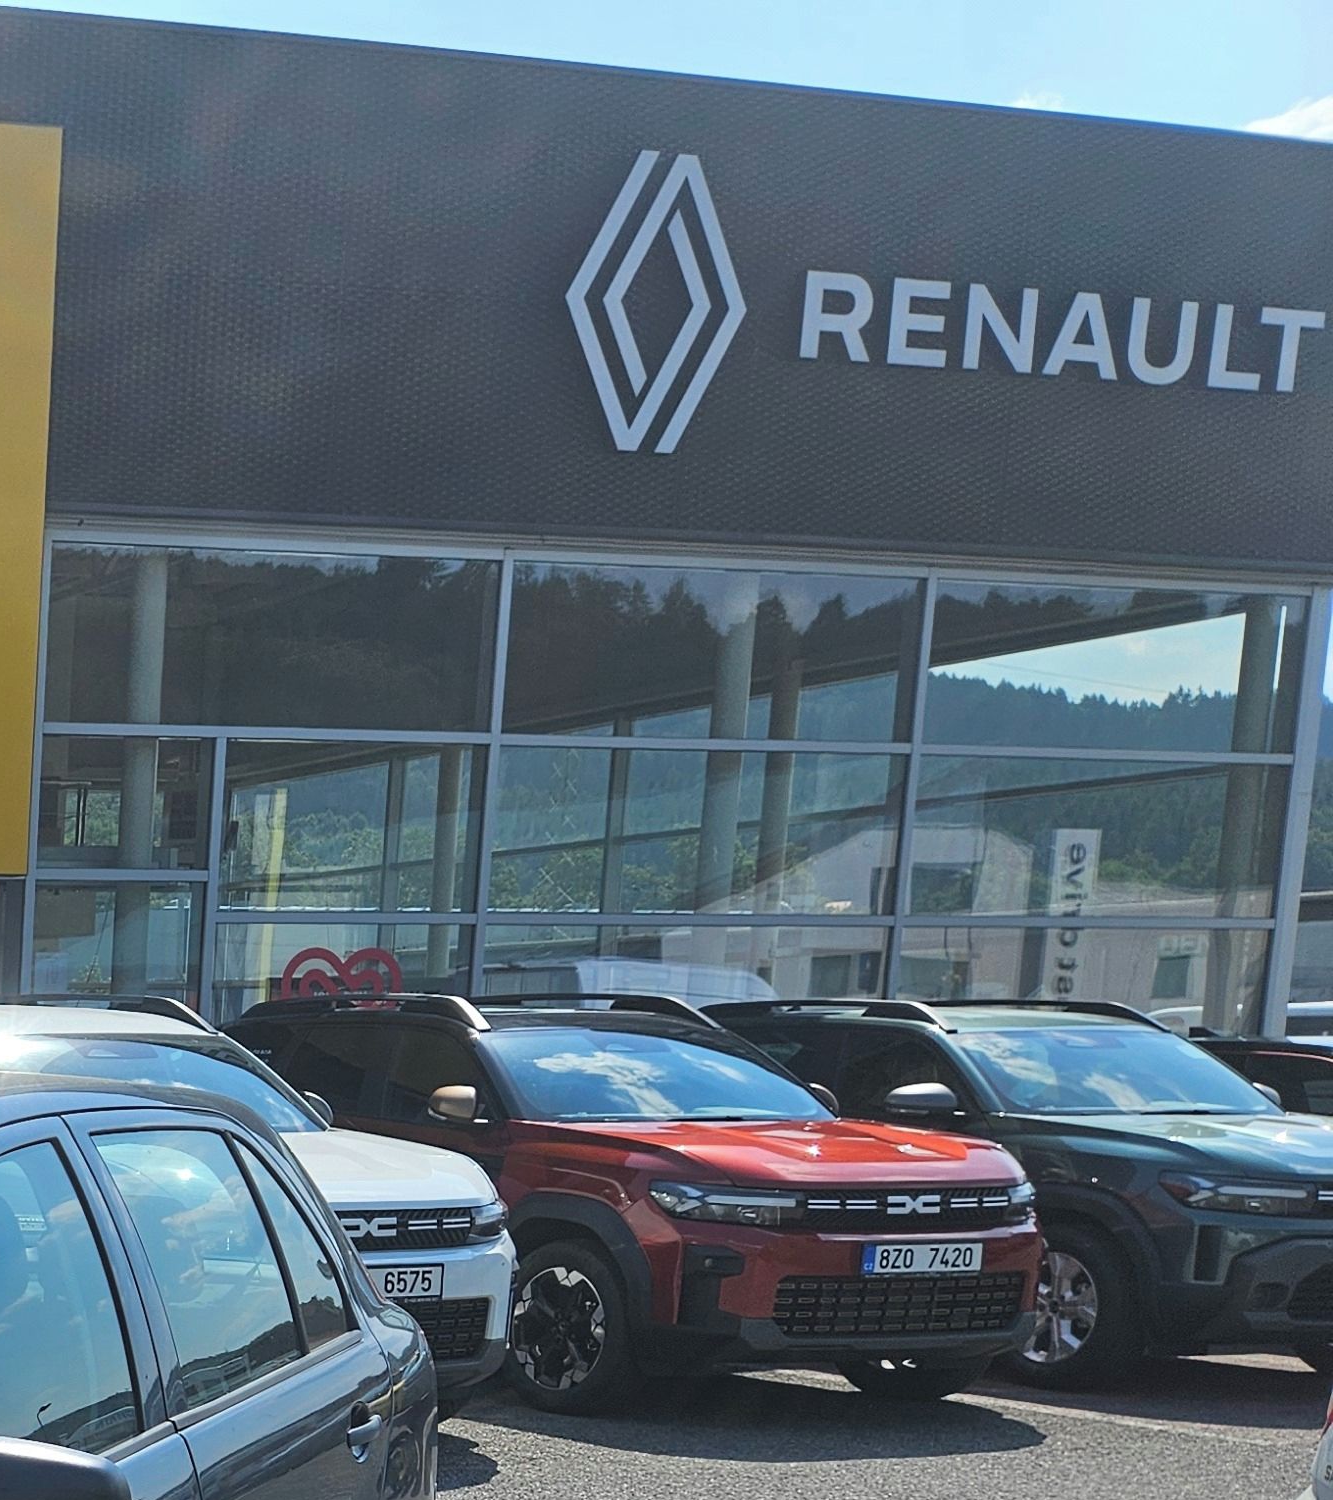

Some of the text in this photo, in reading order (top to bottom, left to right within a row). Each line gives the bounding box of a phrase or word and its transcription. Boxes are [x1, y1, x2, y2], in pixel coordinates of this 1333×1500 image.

[799, 269, 1326, 392] RENAULT
[879, 1247, 973, 1269] 8Z0 7420
[384, 1270, 433, 1293] 6575
